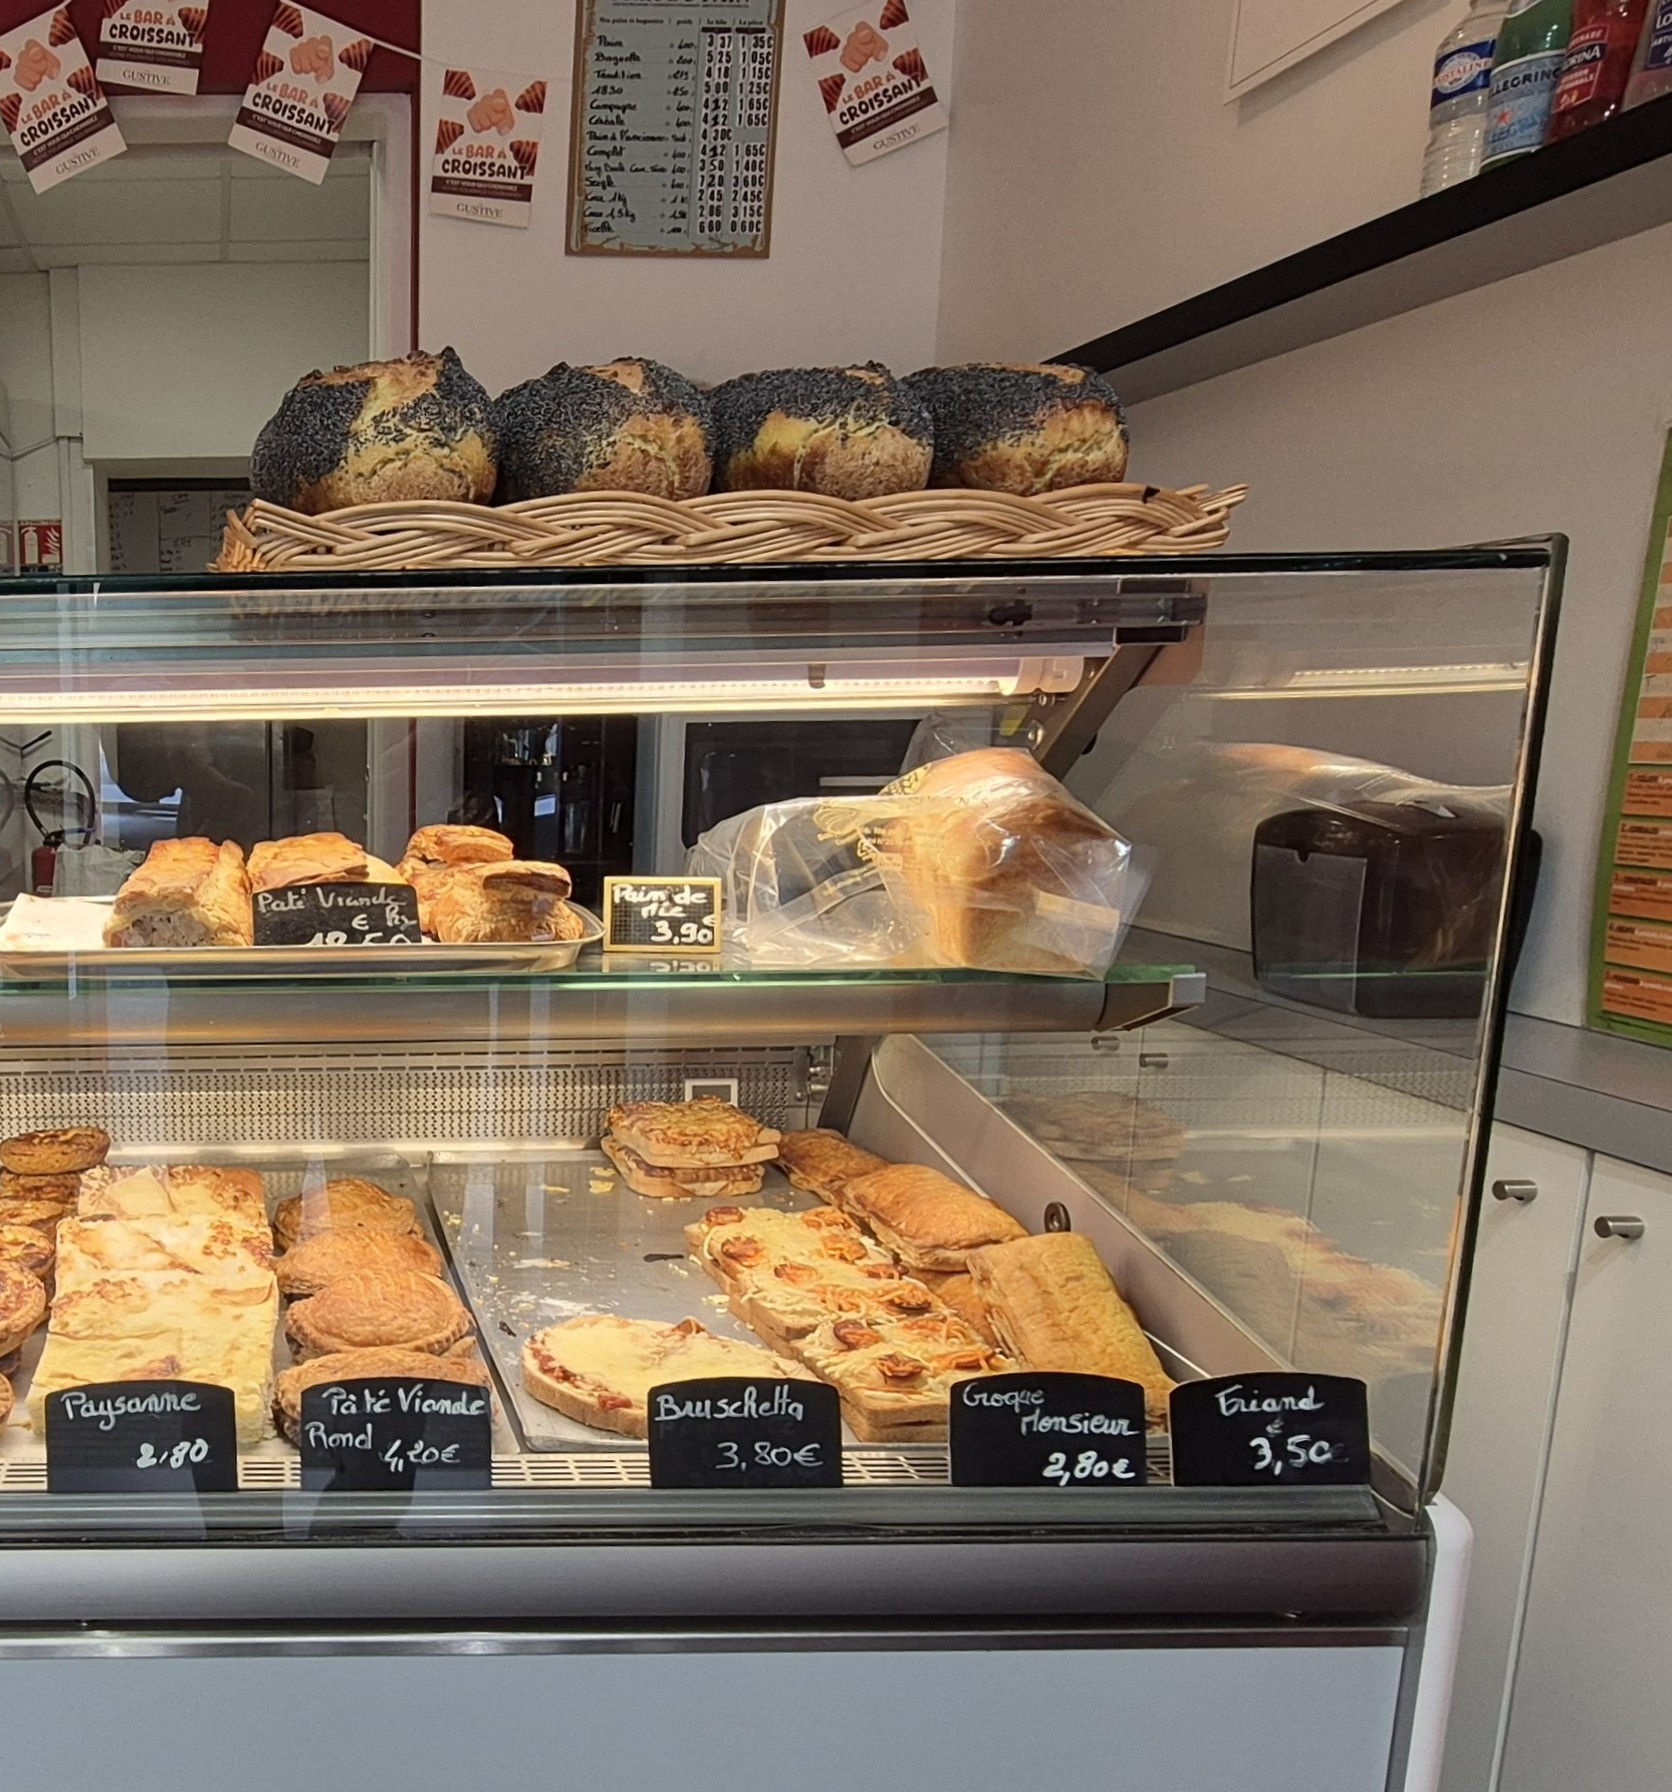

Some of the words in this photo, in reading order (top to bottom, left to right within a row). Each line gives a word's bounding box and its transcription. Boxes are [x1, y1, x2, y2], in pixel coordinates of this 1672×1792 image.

[134, 9, 164, 25] BAR
[109, 23, 196, 48] CROISSANT
[278, 83, 308, 105] BAR
[839, 74, 922, 126] CROISSANT
[853, 75, 883, 100] BAR
[20, 91, 98, 146] CROISSANT
[31, 94, 60, 120] BAR
[252, 92, 335, 135] CROISSANT
[466, 144, 495, 159] BAR
[441, 158, 527, 180] CROISSANT
[613, 884, 666, 903] Pain
[672, 884, 708, 905] de
[61, 1390, 202, 1431] Paysanne
[398, 1384, 487, 1415] Viande
[1214, 1384, 1325, 1417] Friand
[305, 1421, 373, 1449] Rond
[715, 1442, 824, 1471] 3,80€
[1042, 1450, 1136, 1486] 2,80€
